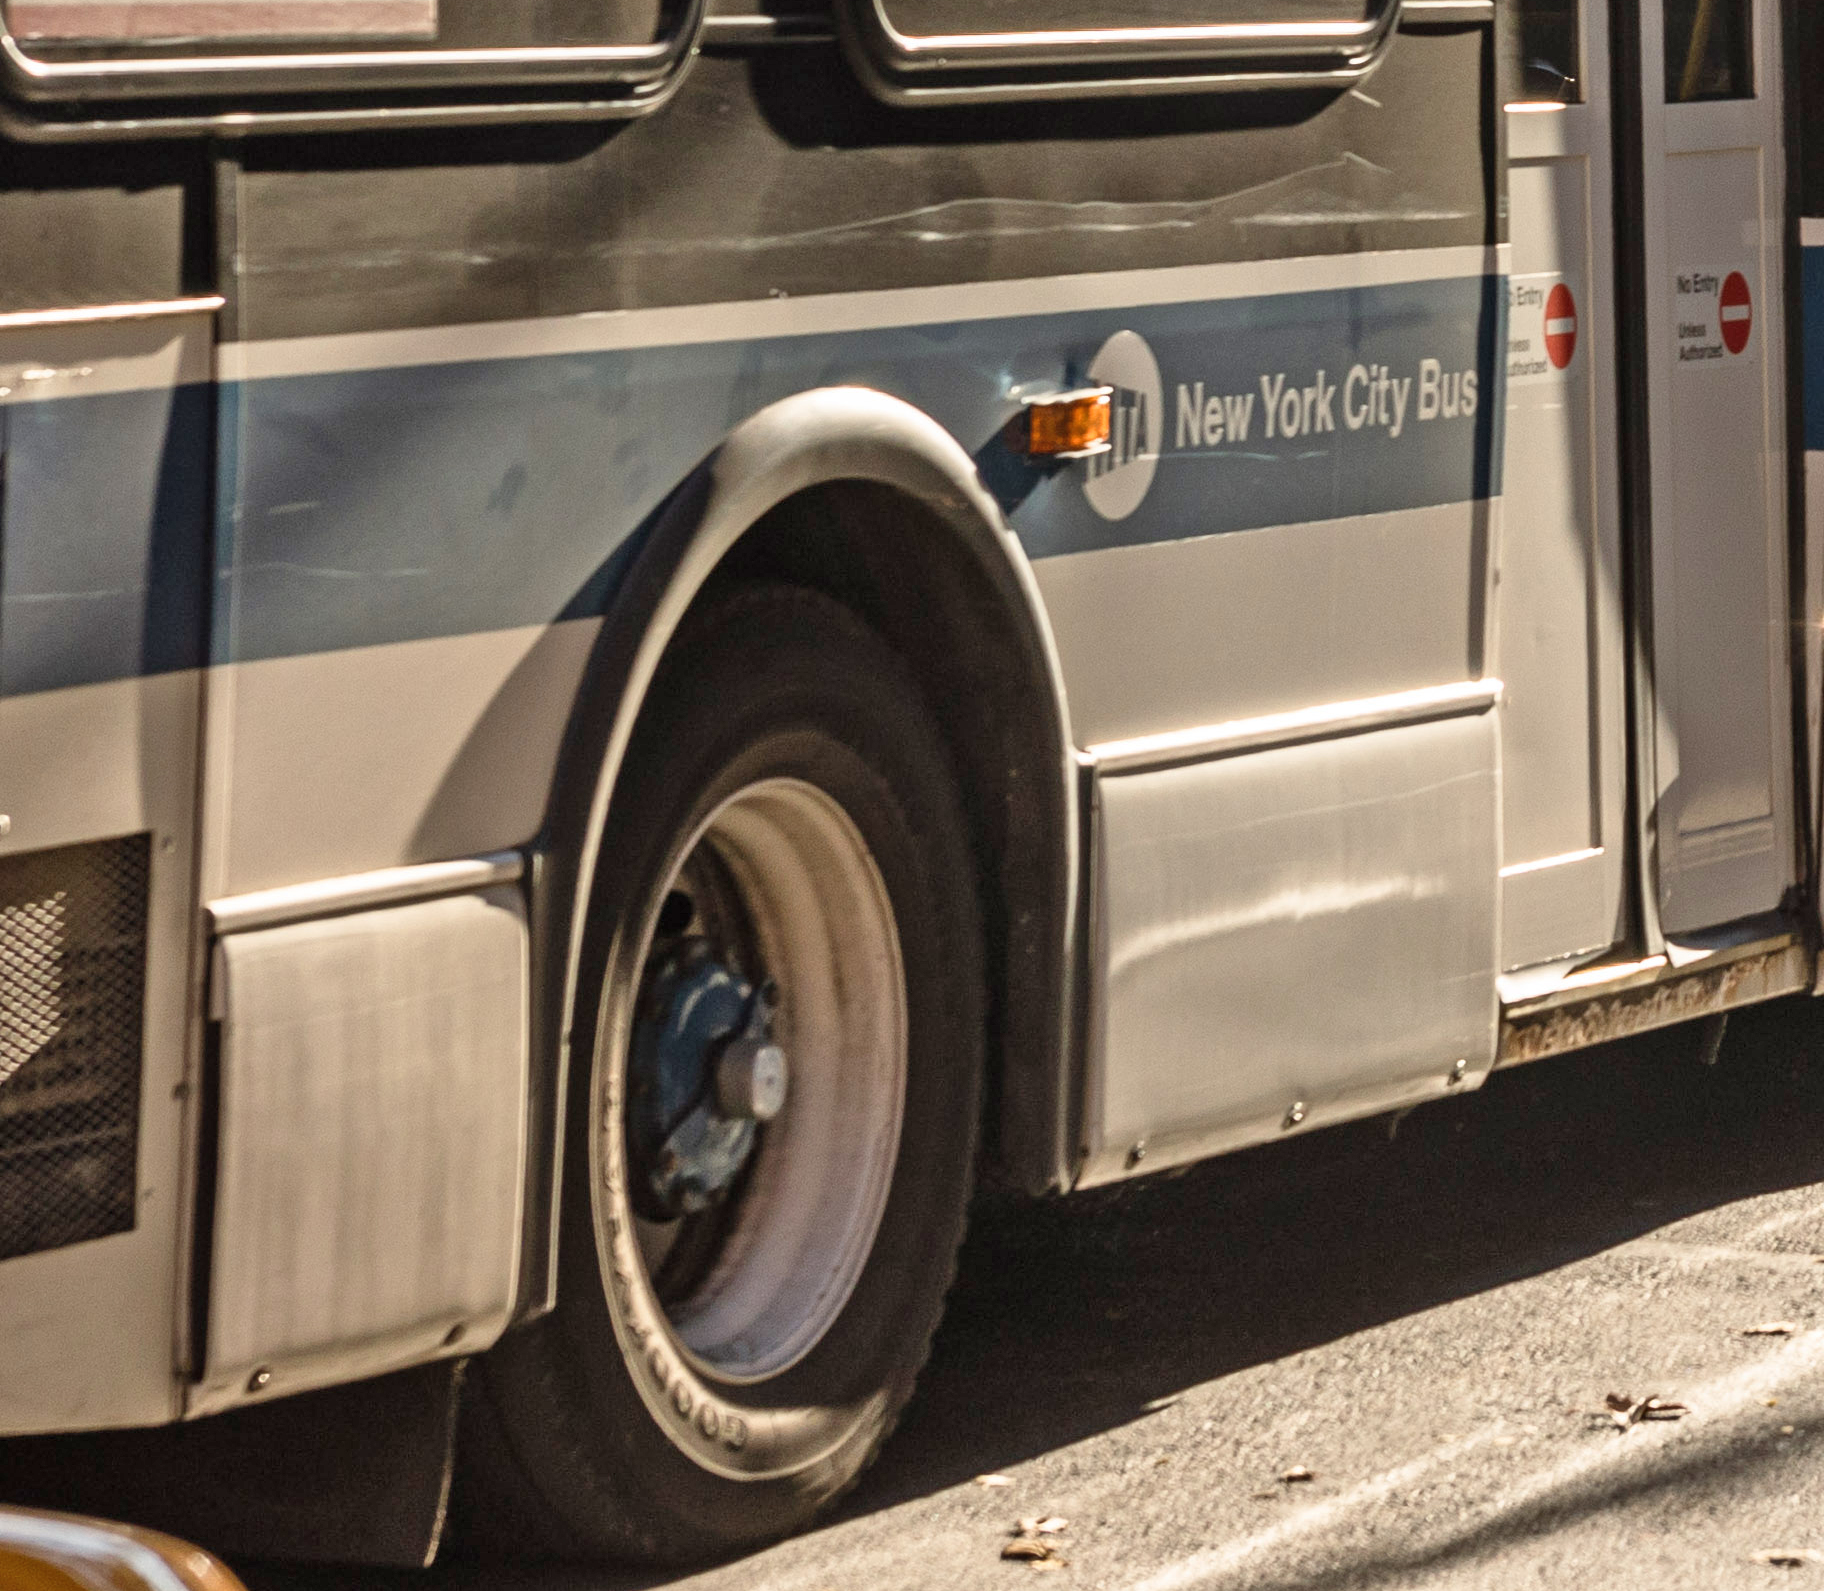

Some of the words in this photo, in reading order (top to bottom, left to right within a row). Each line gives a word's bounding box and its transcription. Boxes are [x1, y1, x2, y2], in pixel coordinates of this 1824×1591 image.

[1678, 275, 1691, 294] No
[1693, 273, 1718, 296] Entry
[1517, 287, 1545, 309] Entry
[1175, 381, 1256, 449] New
[1260, 369, 1337, 439] York
[1343, 363, 1412, 439] City
[1418, 357, 1479, 422] Bus
